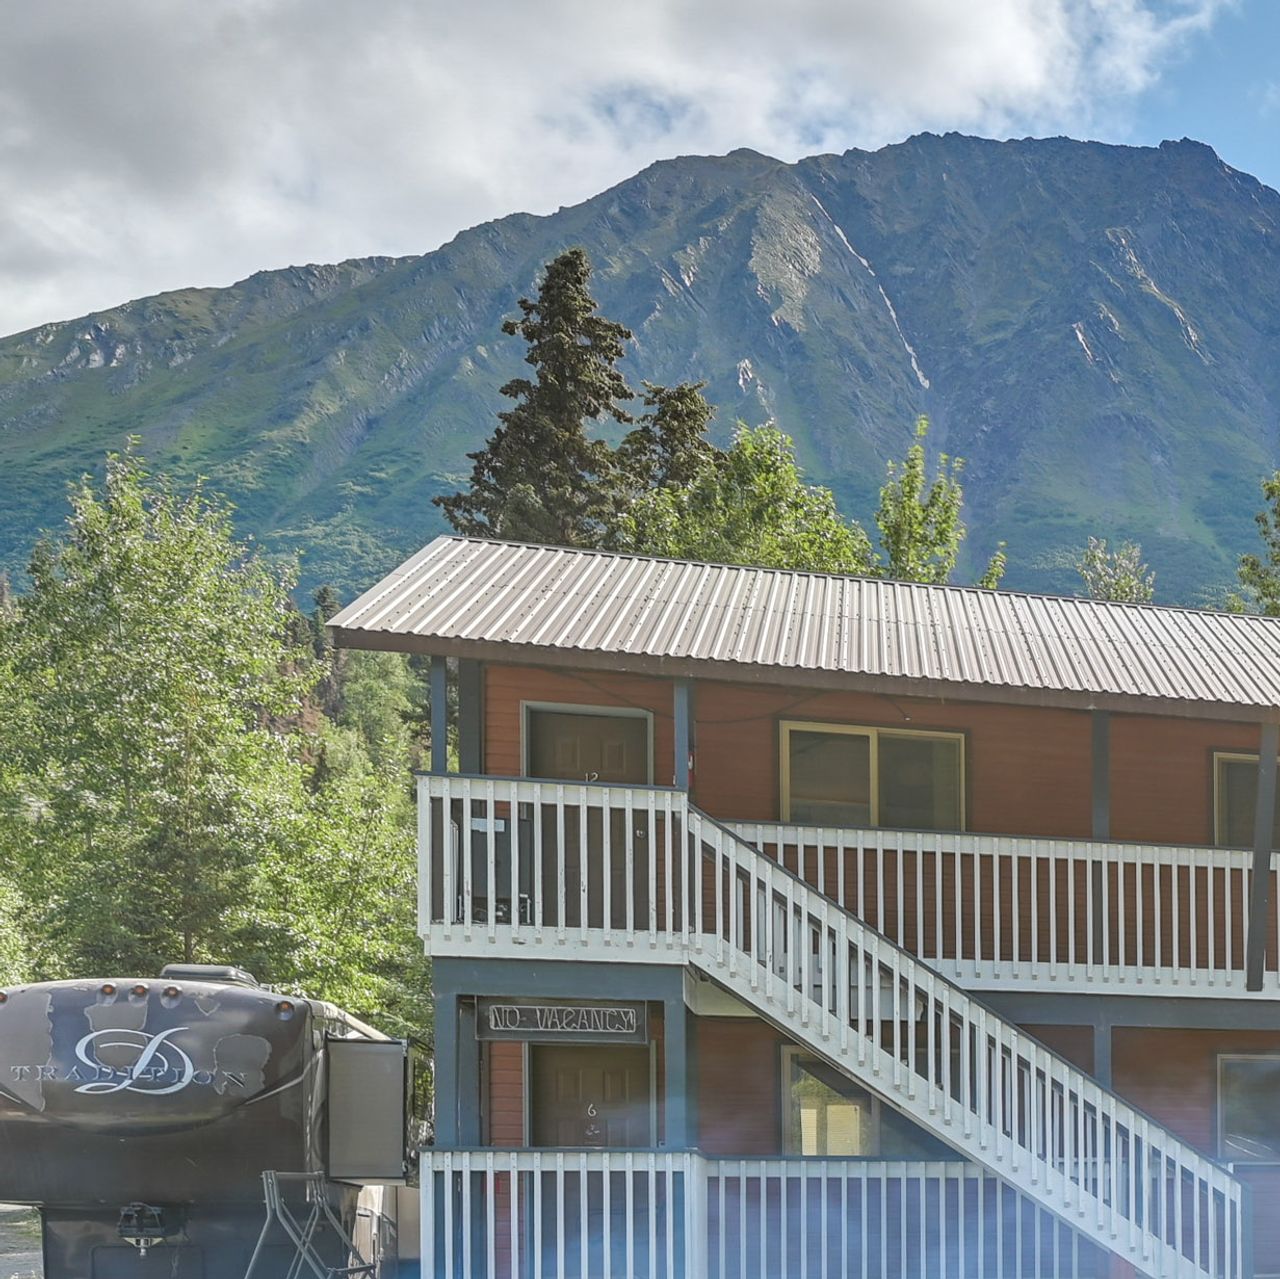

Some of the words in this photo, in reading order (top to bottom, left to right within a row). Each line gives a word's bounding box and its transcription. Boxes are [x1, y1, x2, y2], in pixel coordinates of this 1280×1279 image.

[489, 1006, 521, 1030] NO
[535, 1007, 636, 1033] VACANCY
[10, 1064, 249, 1089] TRADITION
[587, 1103, 597, 1117] 6
